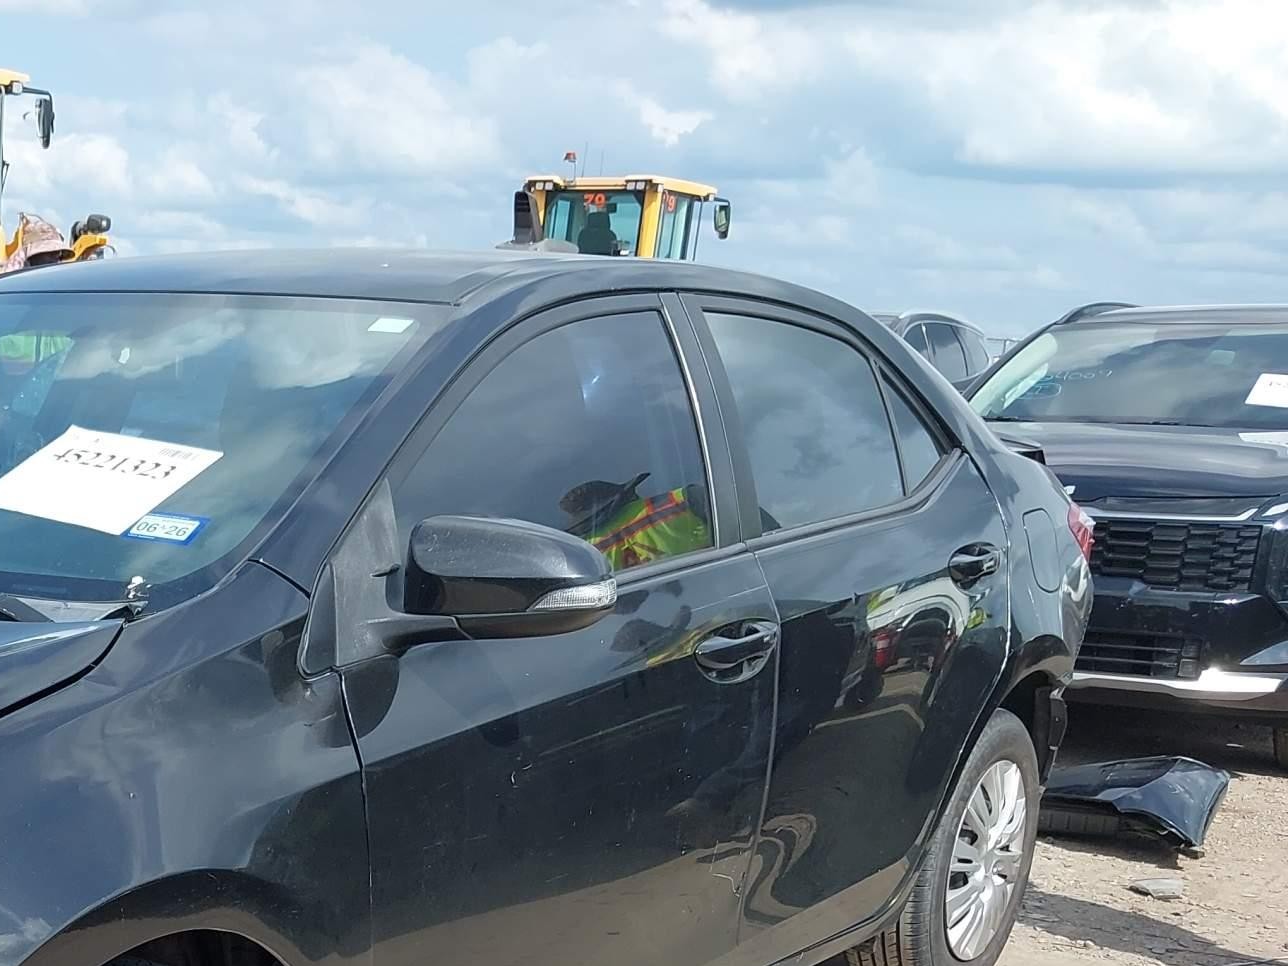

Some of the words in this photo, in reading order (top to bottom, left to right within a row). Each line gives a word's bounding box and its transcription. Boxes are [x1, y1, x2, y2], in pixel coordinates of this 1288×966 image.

[53, 448, 177, 479] 45221323
[136, 521, 159, 533] 06
[164, 525, 189, 537] 26
